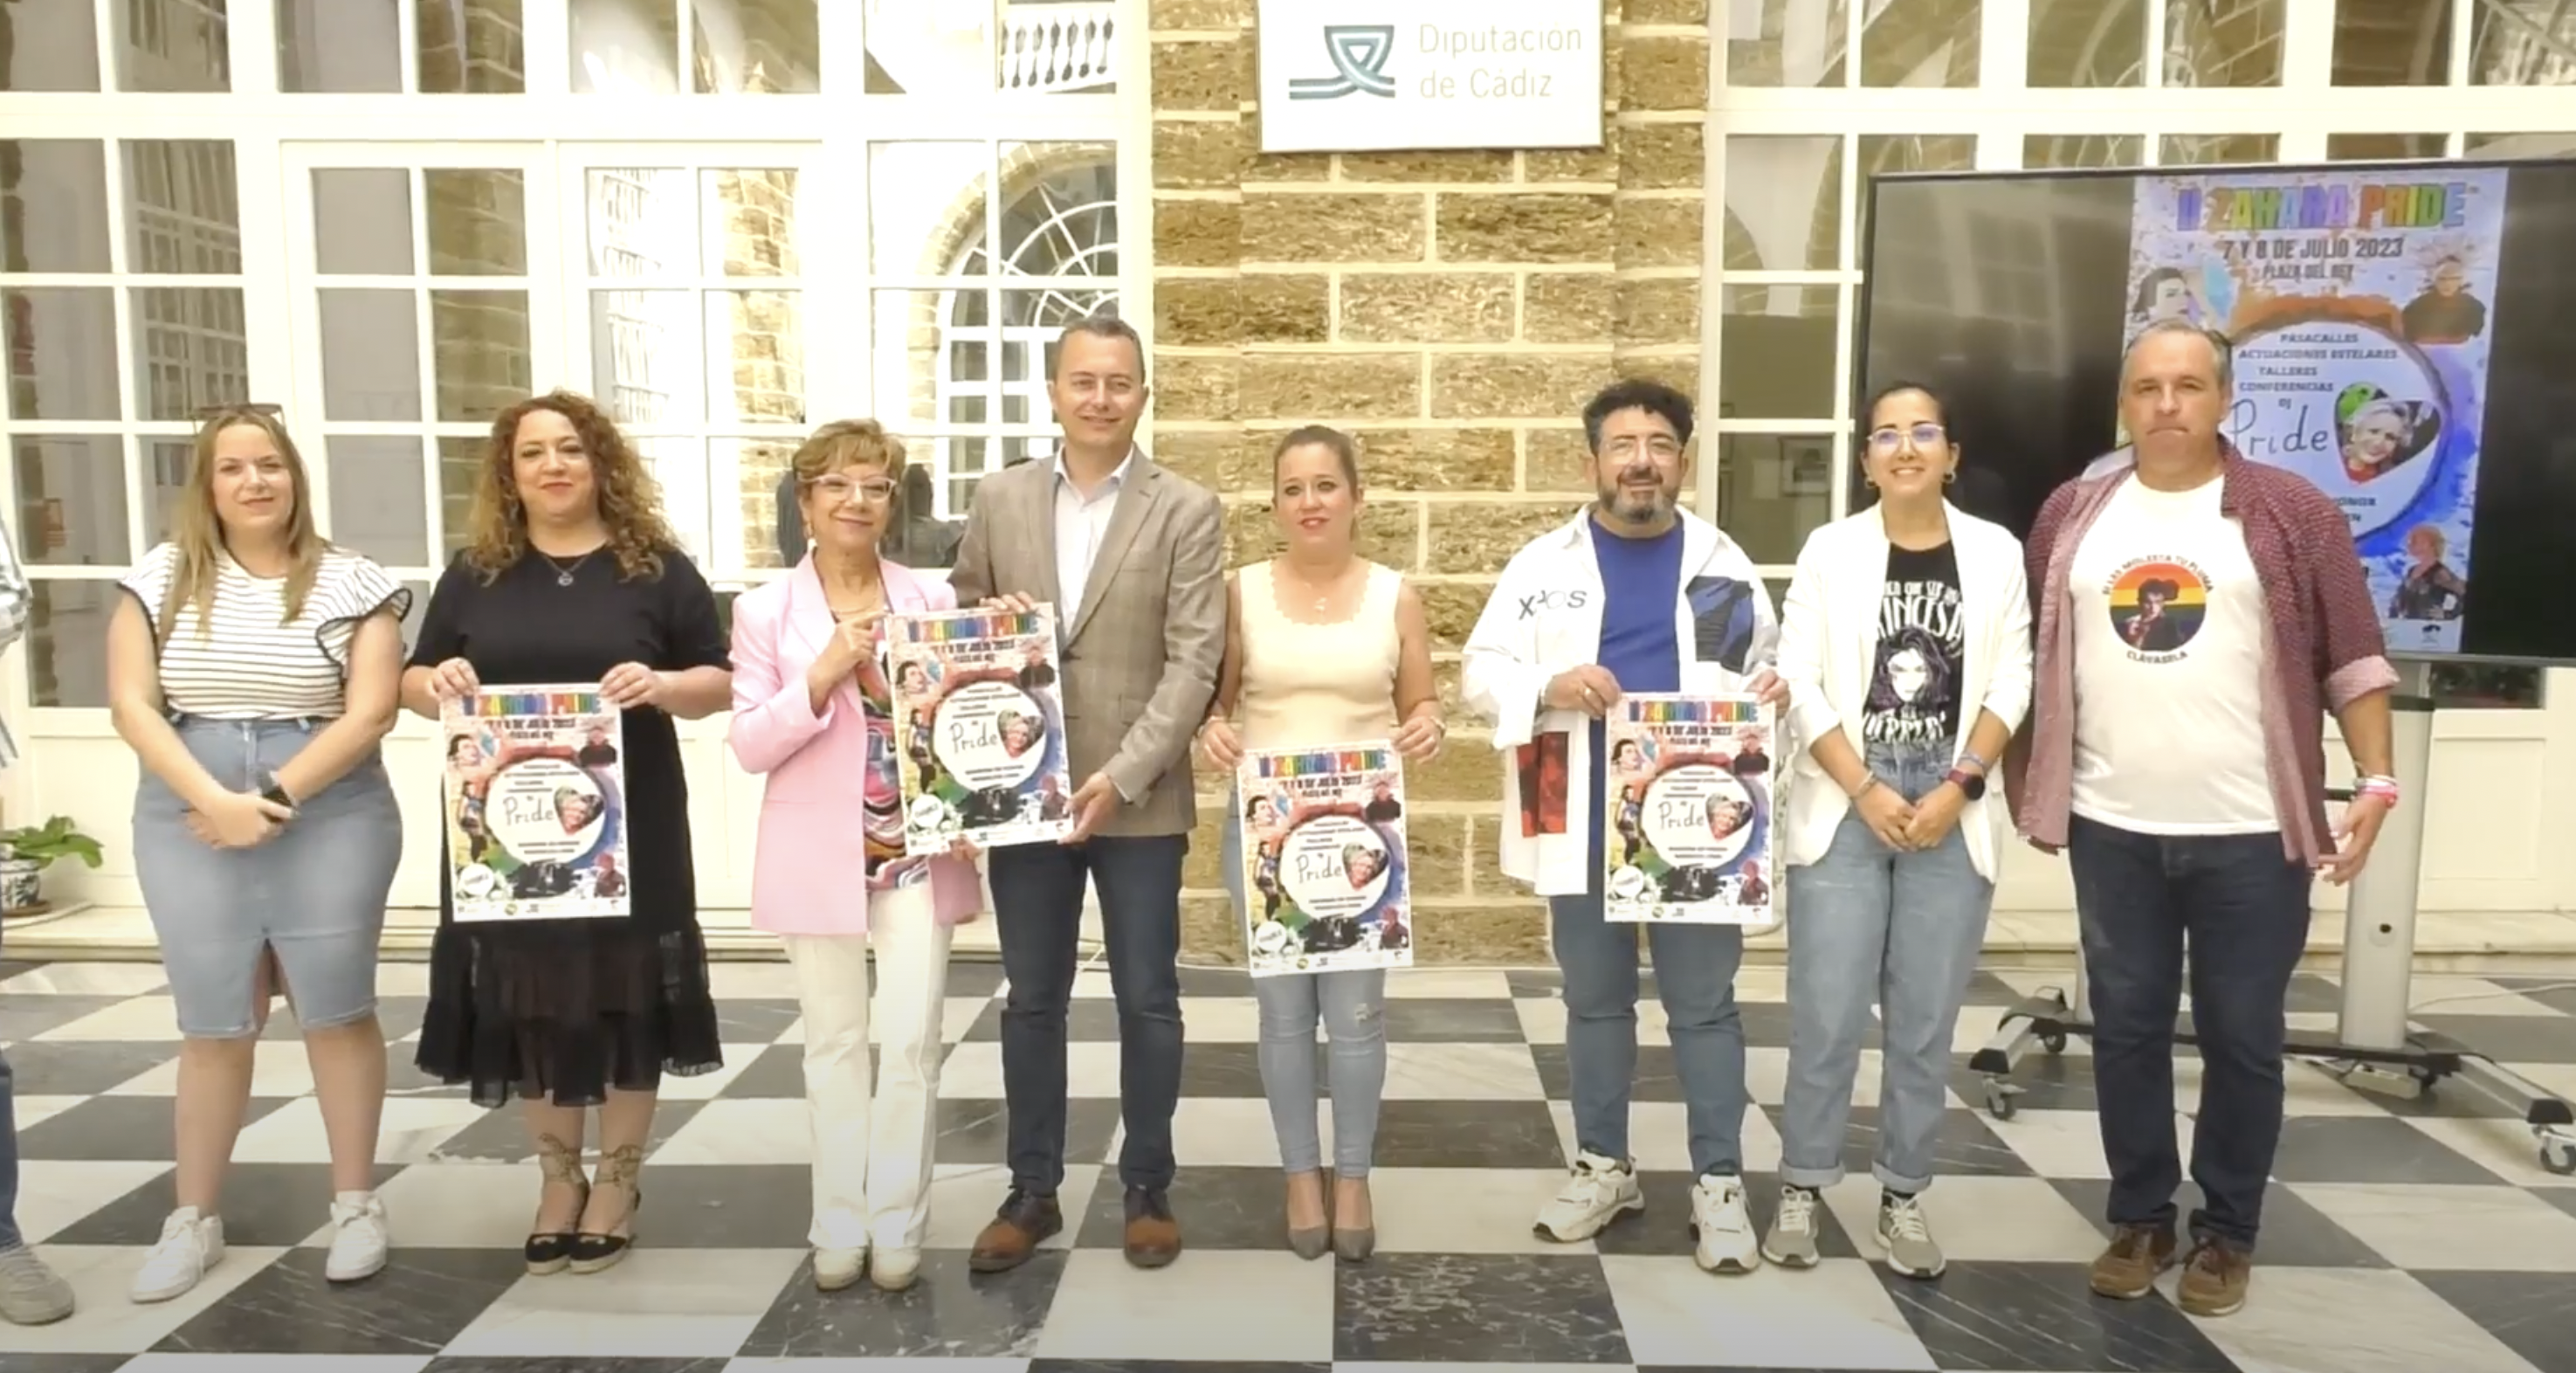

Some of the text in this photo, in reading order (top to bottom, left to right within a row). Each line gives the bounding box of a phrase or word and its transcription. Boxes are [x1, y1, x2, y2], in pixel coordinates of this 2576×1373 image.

[1419, 23, 1582, 59] Diputación
[1420, 68, 1553, 99] de Cádiz
[2206, 183, 2350, 232] ZAHARA
[2358, 182, 2467, 230] PRIDE
[2223, 238, 2234, 259] 7
[2240, 238, 2251, 259] Y
[2273, 238, 2294, 259] DE
[2300, 238, 2349, 259] JULIO
[2357, 236, 2405, 259] 2023
[2280, 333, 2359, 343] PASACALLES
[2238, 349, 2398, 360] ACTUACIONES ESTELARES
[2239, 382, 2333, 391] CONFERENCIAS
[2258, 366, 2318, 376] TALLERES
[2229, 398, 2329, 456] Pride
[948, 721, 997, 754] Pride
[502, 795, 554, 826] Pride
[1657, 801, 1705, 829] Pride
[1295, 853, 1342, 885] Pride
